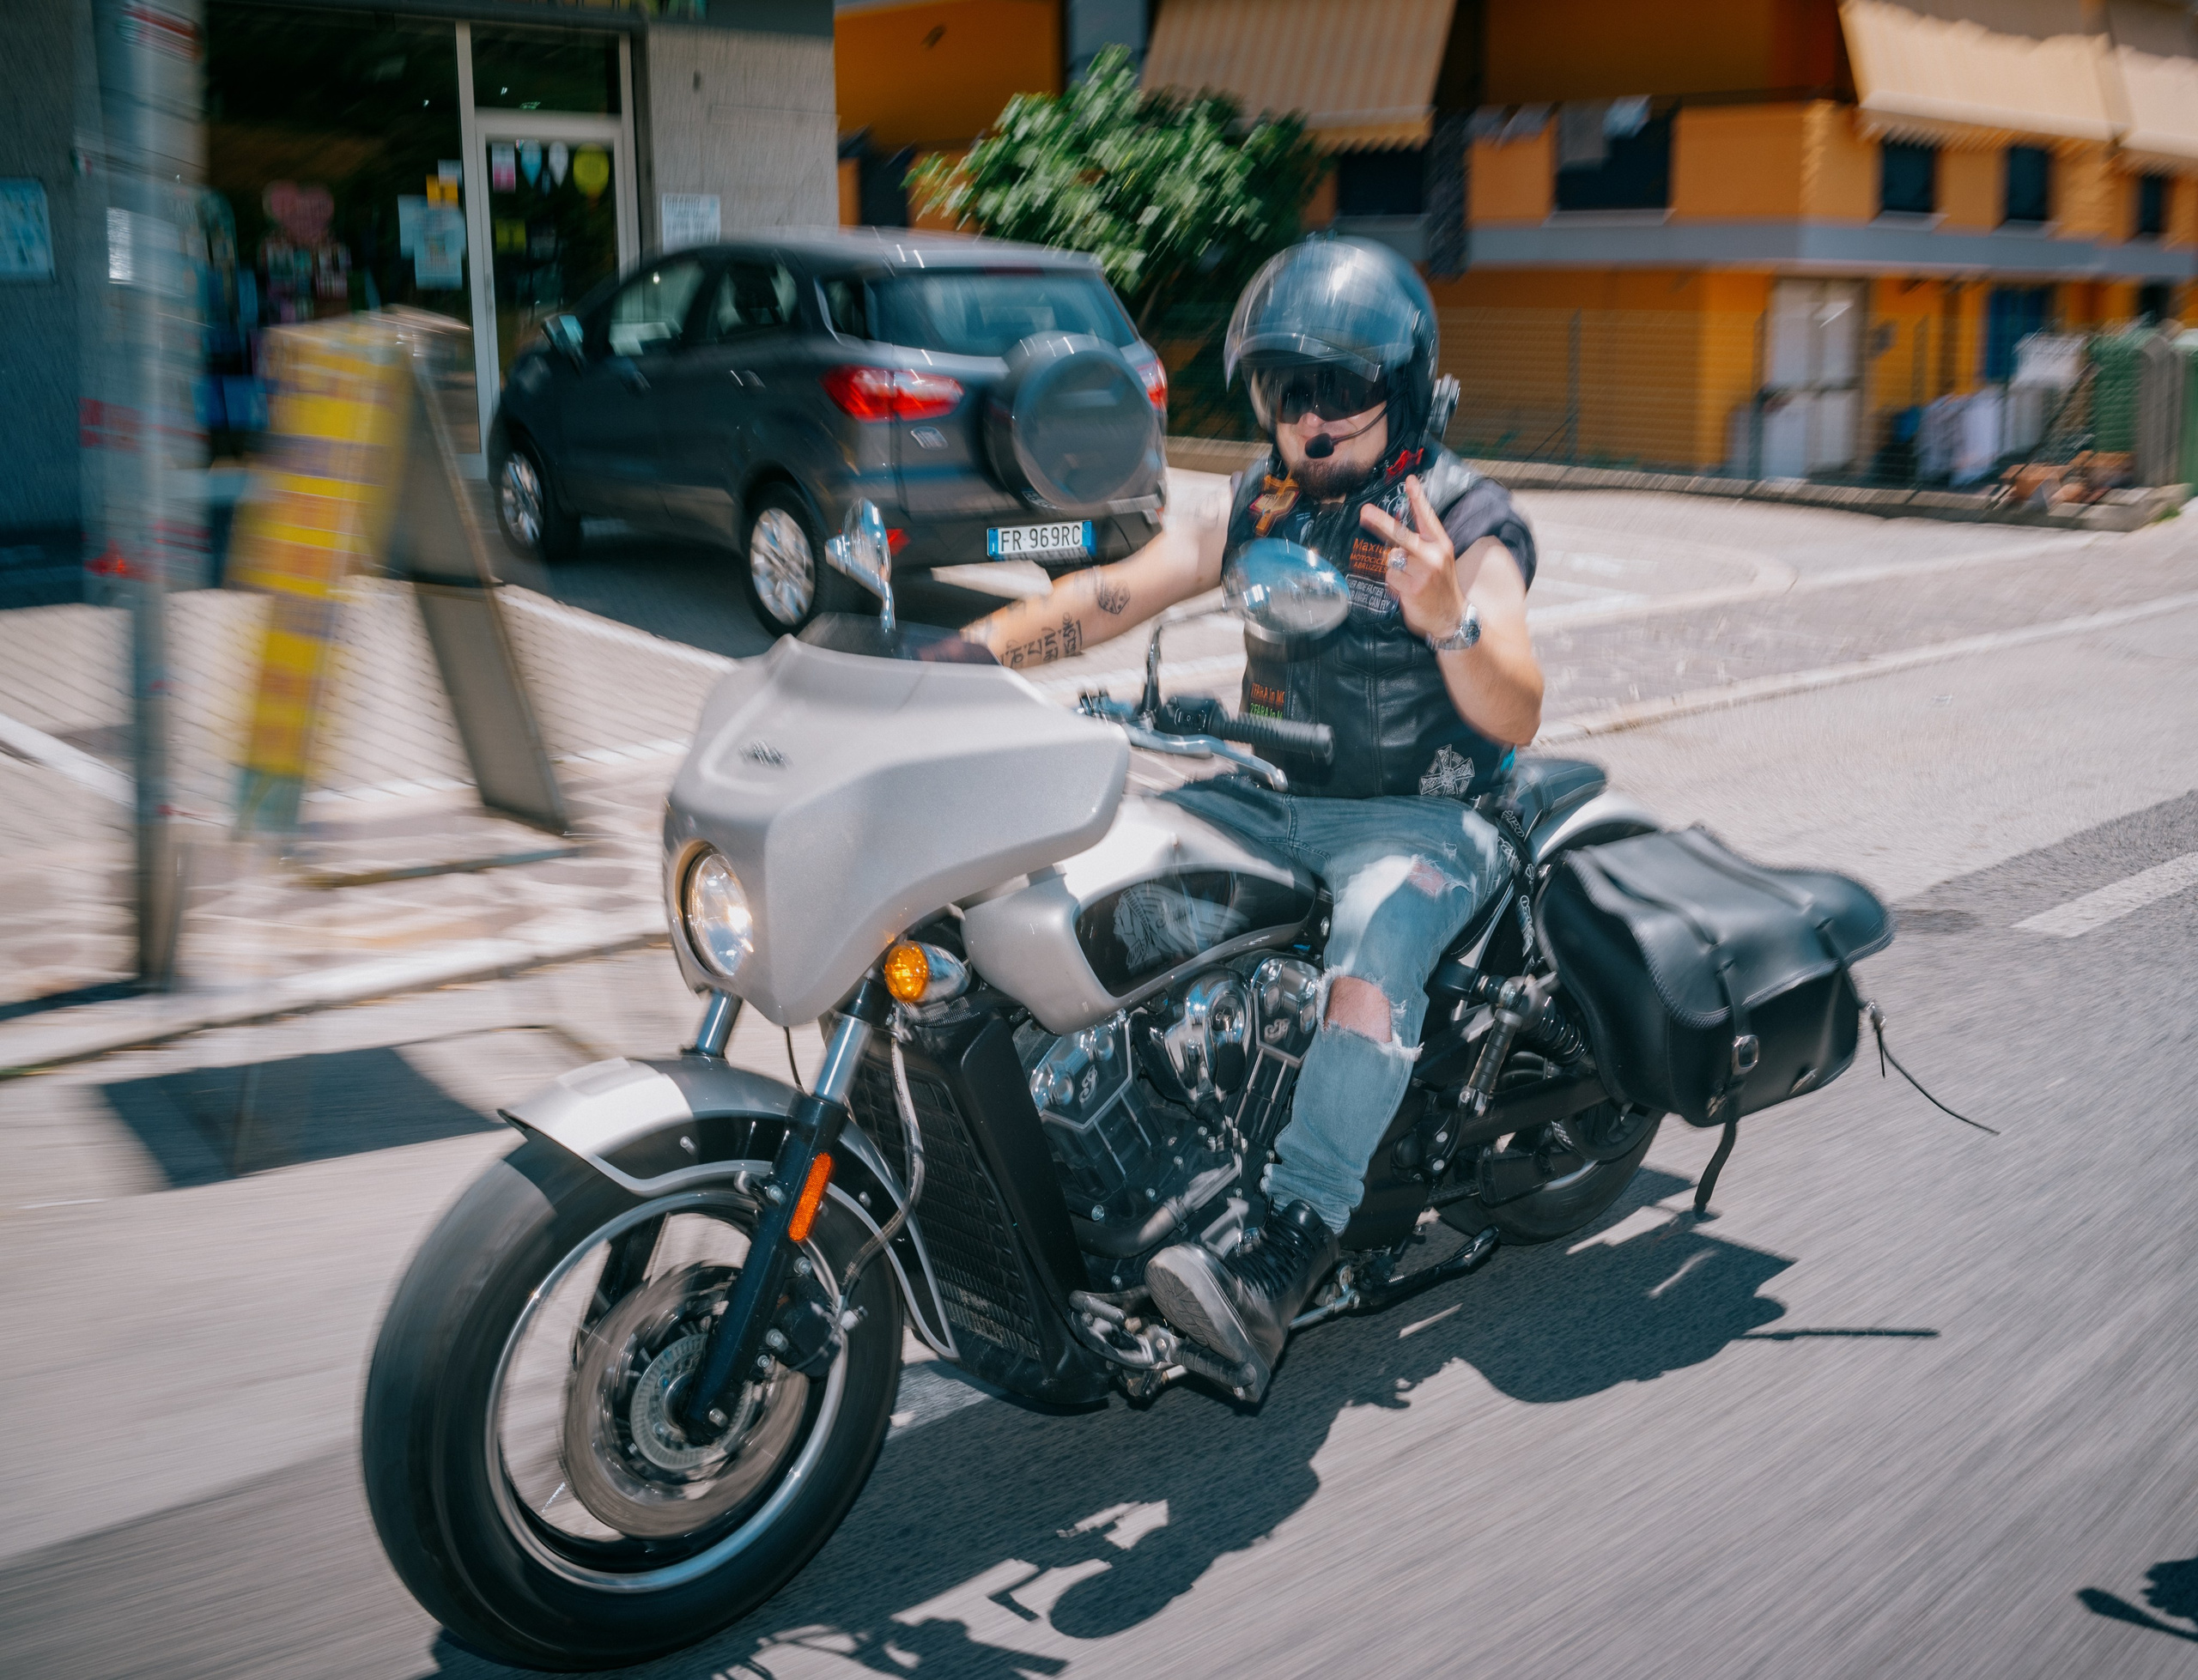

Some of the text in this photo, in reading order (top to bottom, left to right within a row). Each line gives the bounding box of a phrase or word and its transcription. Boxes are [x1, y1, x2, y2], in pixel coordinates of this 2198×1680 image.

[1000, 525, 1081, 552] FR 969RC
[1354, 561, 1387, 573] ABRUZZES
[1366, 585, 1384, 597] FASTER
[1369, 596, 1381, 610] CAN
